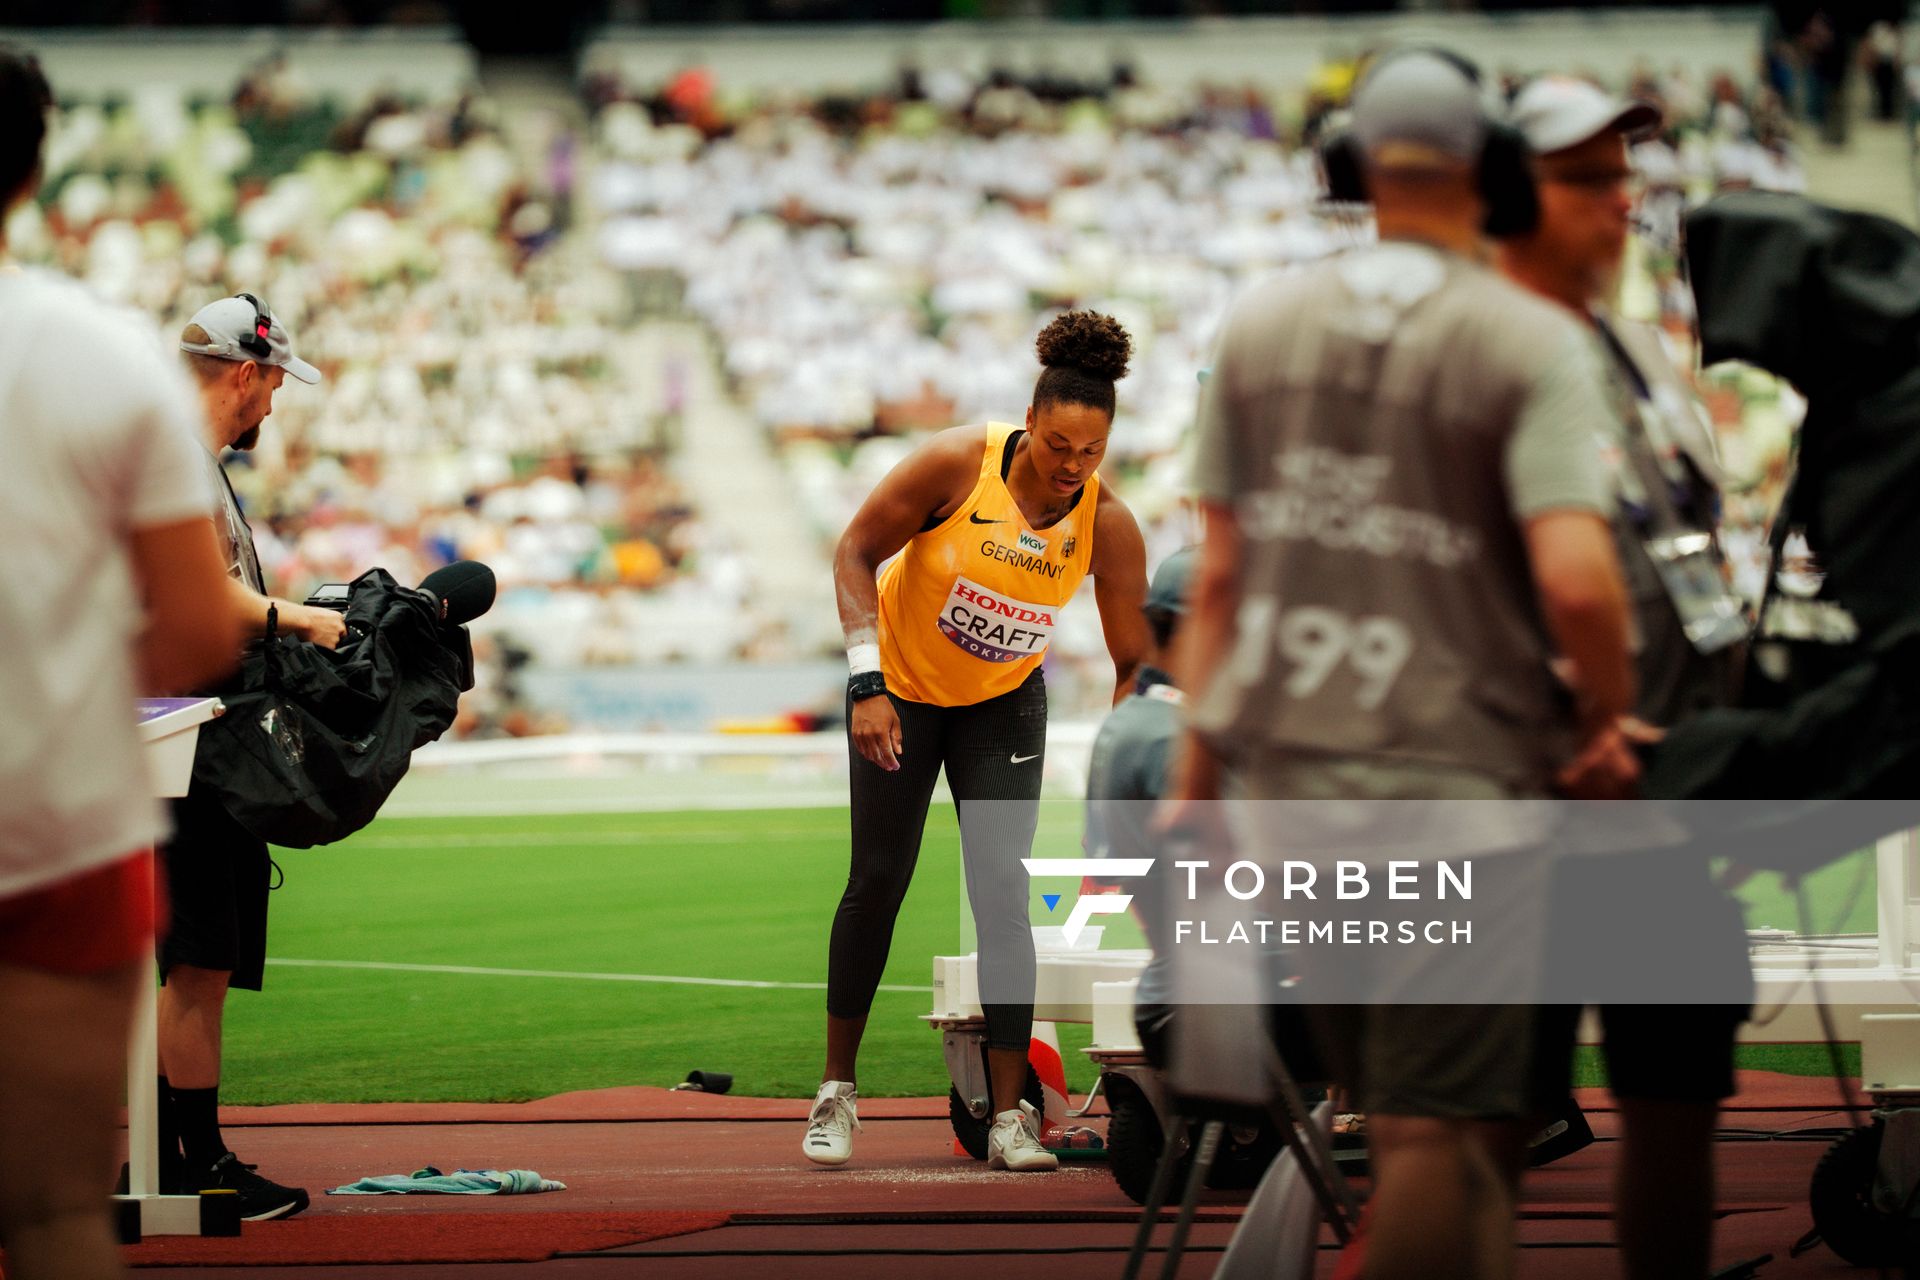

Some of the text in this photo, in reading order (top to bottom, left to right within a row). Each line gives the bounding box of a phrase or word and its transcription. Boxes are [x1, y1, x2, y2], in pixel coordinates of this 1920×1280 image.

[981, 541, 1066, 580] GERMANY
[1019, 534, 1047, 551] WGV
[954, 583, 1055, 627] HONDA
[950, 605, 1045, 649] CRAFT
